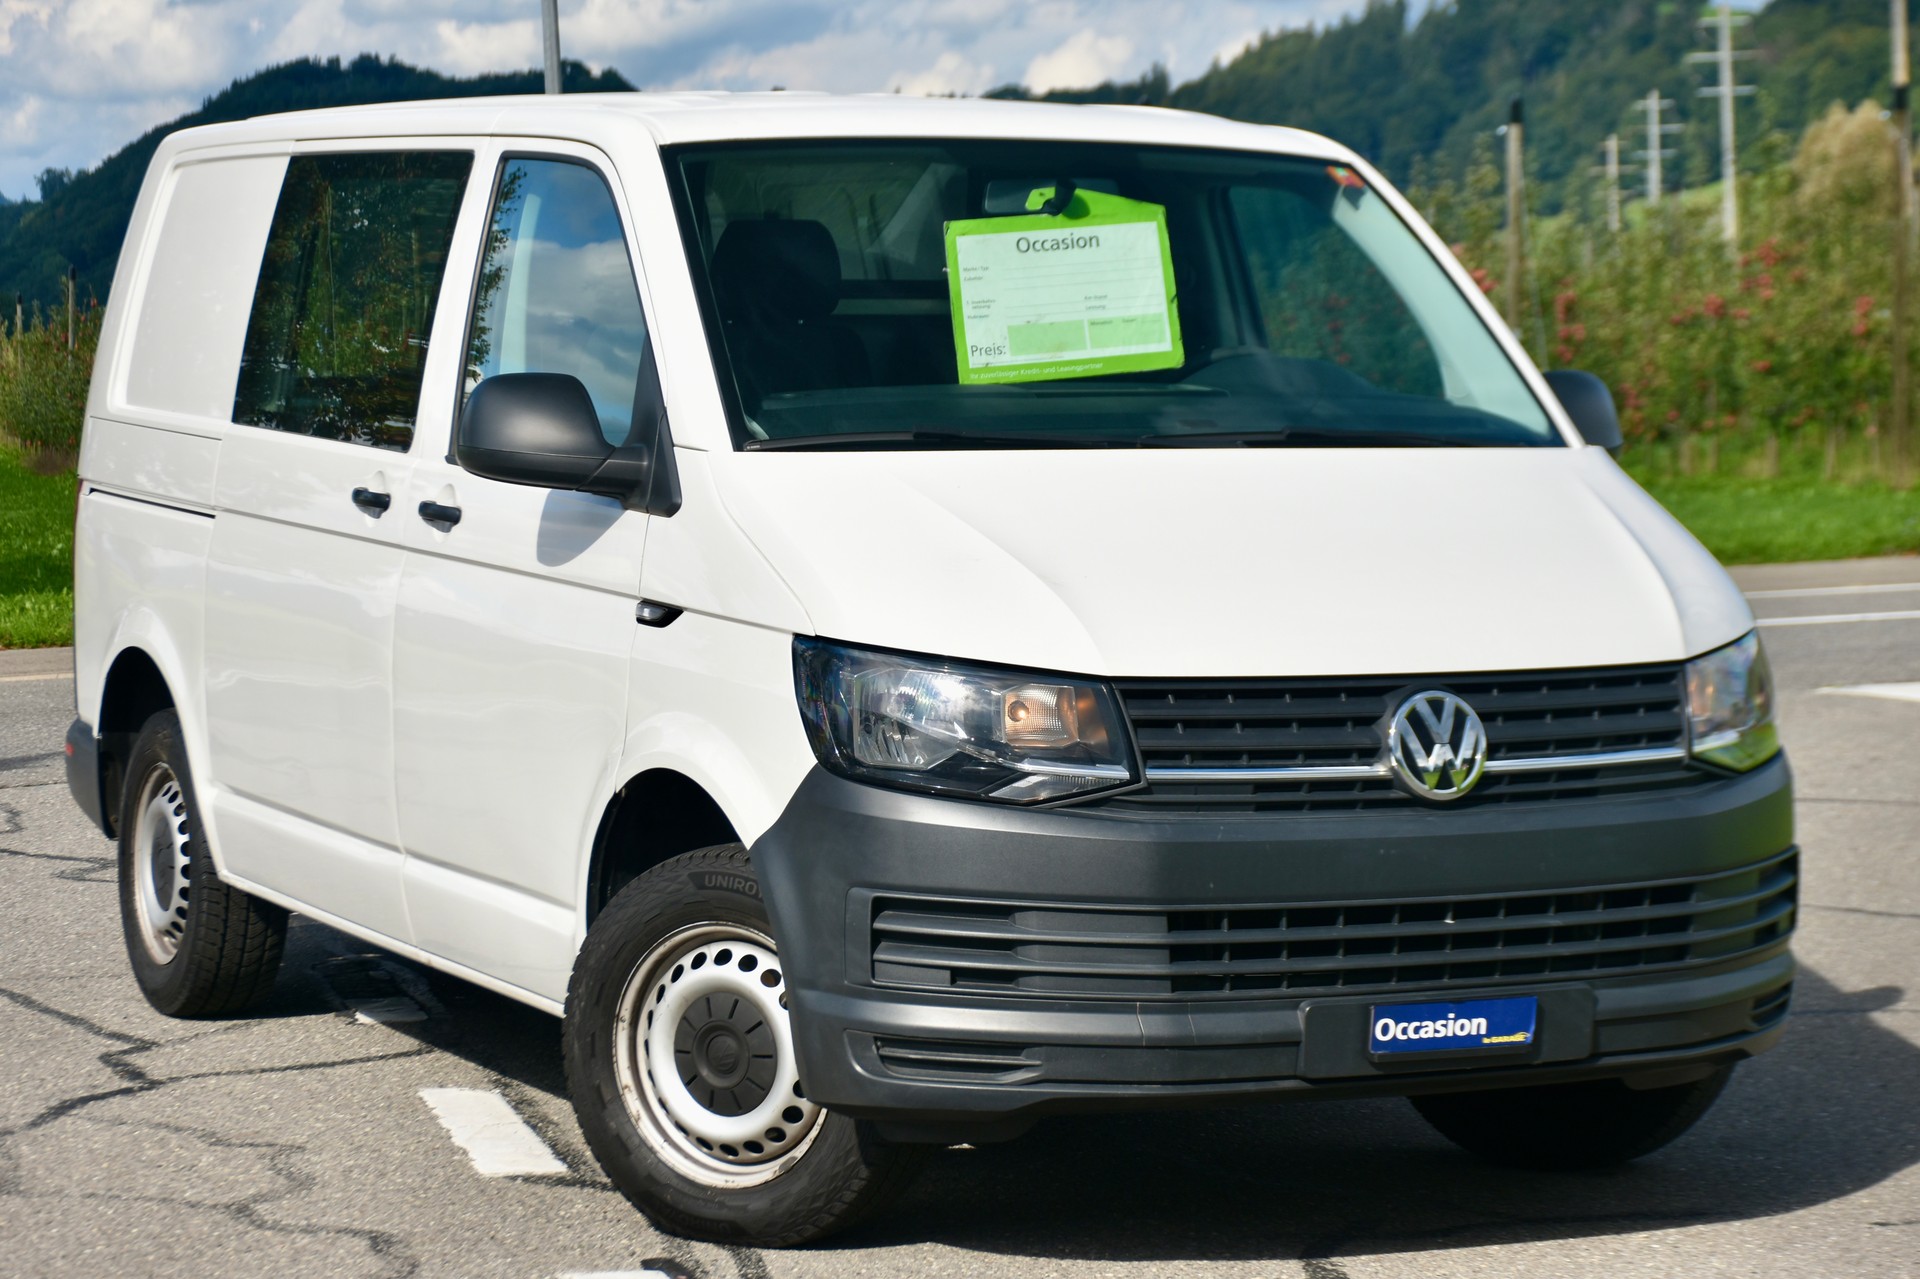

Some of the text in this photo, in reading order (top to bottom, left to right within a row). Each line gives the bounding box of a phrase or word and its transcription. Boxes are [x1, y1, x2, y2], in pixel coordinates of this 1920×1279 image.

[1016, 232, 1100, 253] Occasion
[970, 343, 1007, 357] Preis:
[1042, 365, 1056, 374] und
[704, 874, 763, 898] UNIRO
[1374, 1013, 1487, 1042] Occasion
